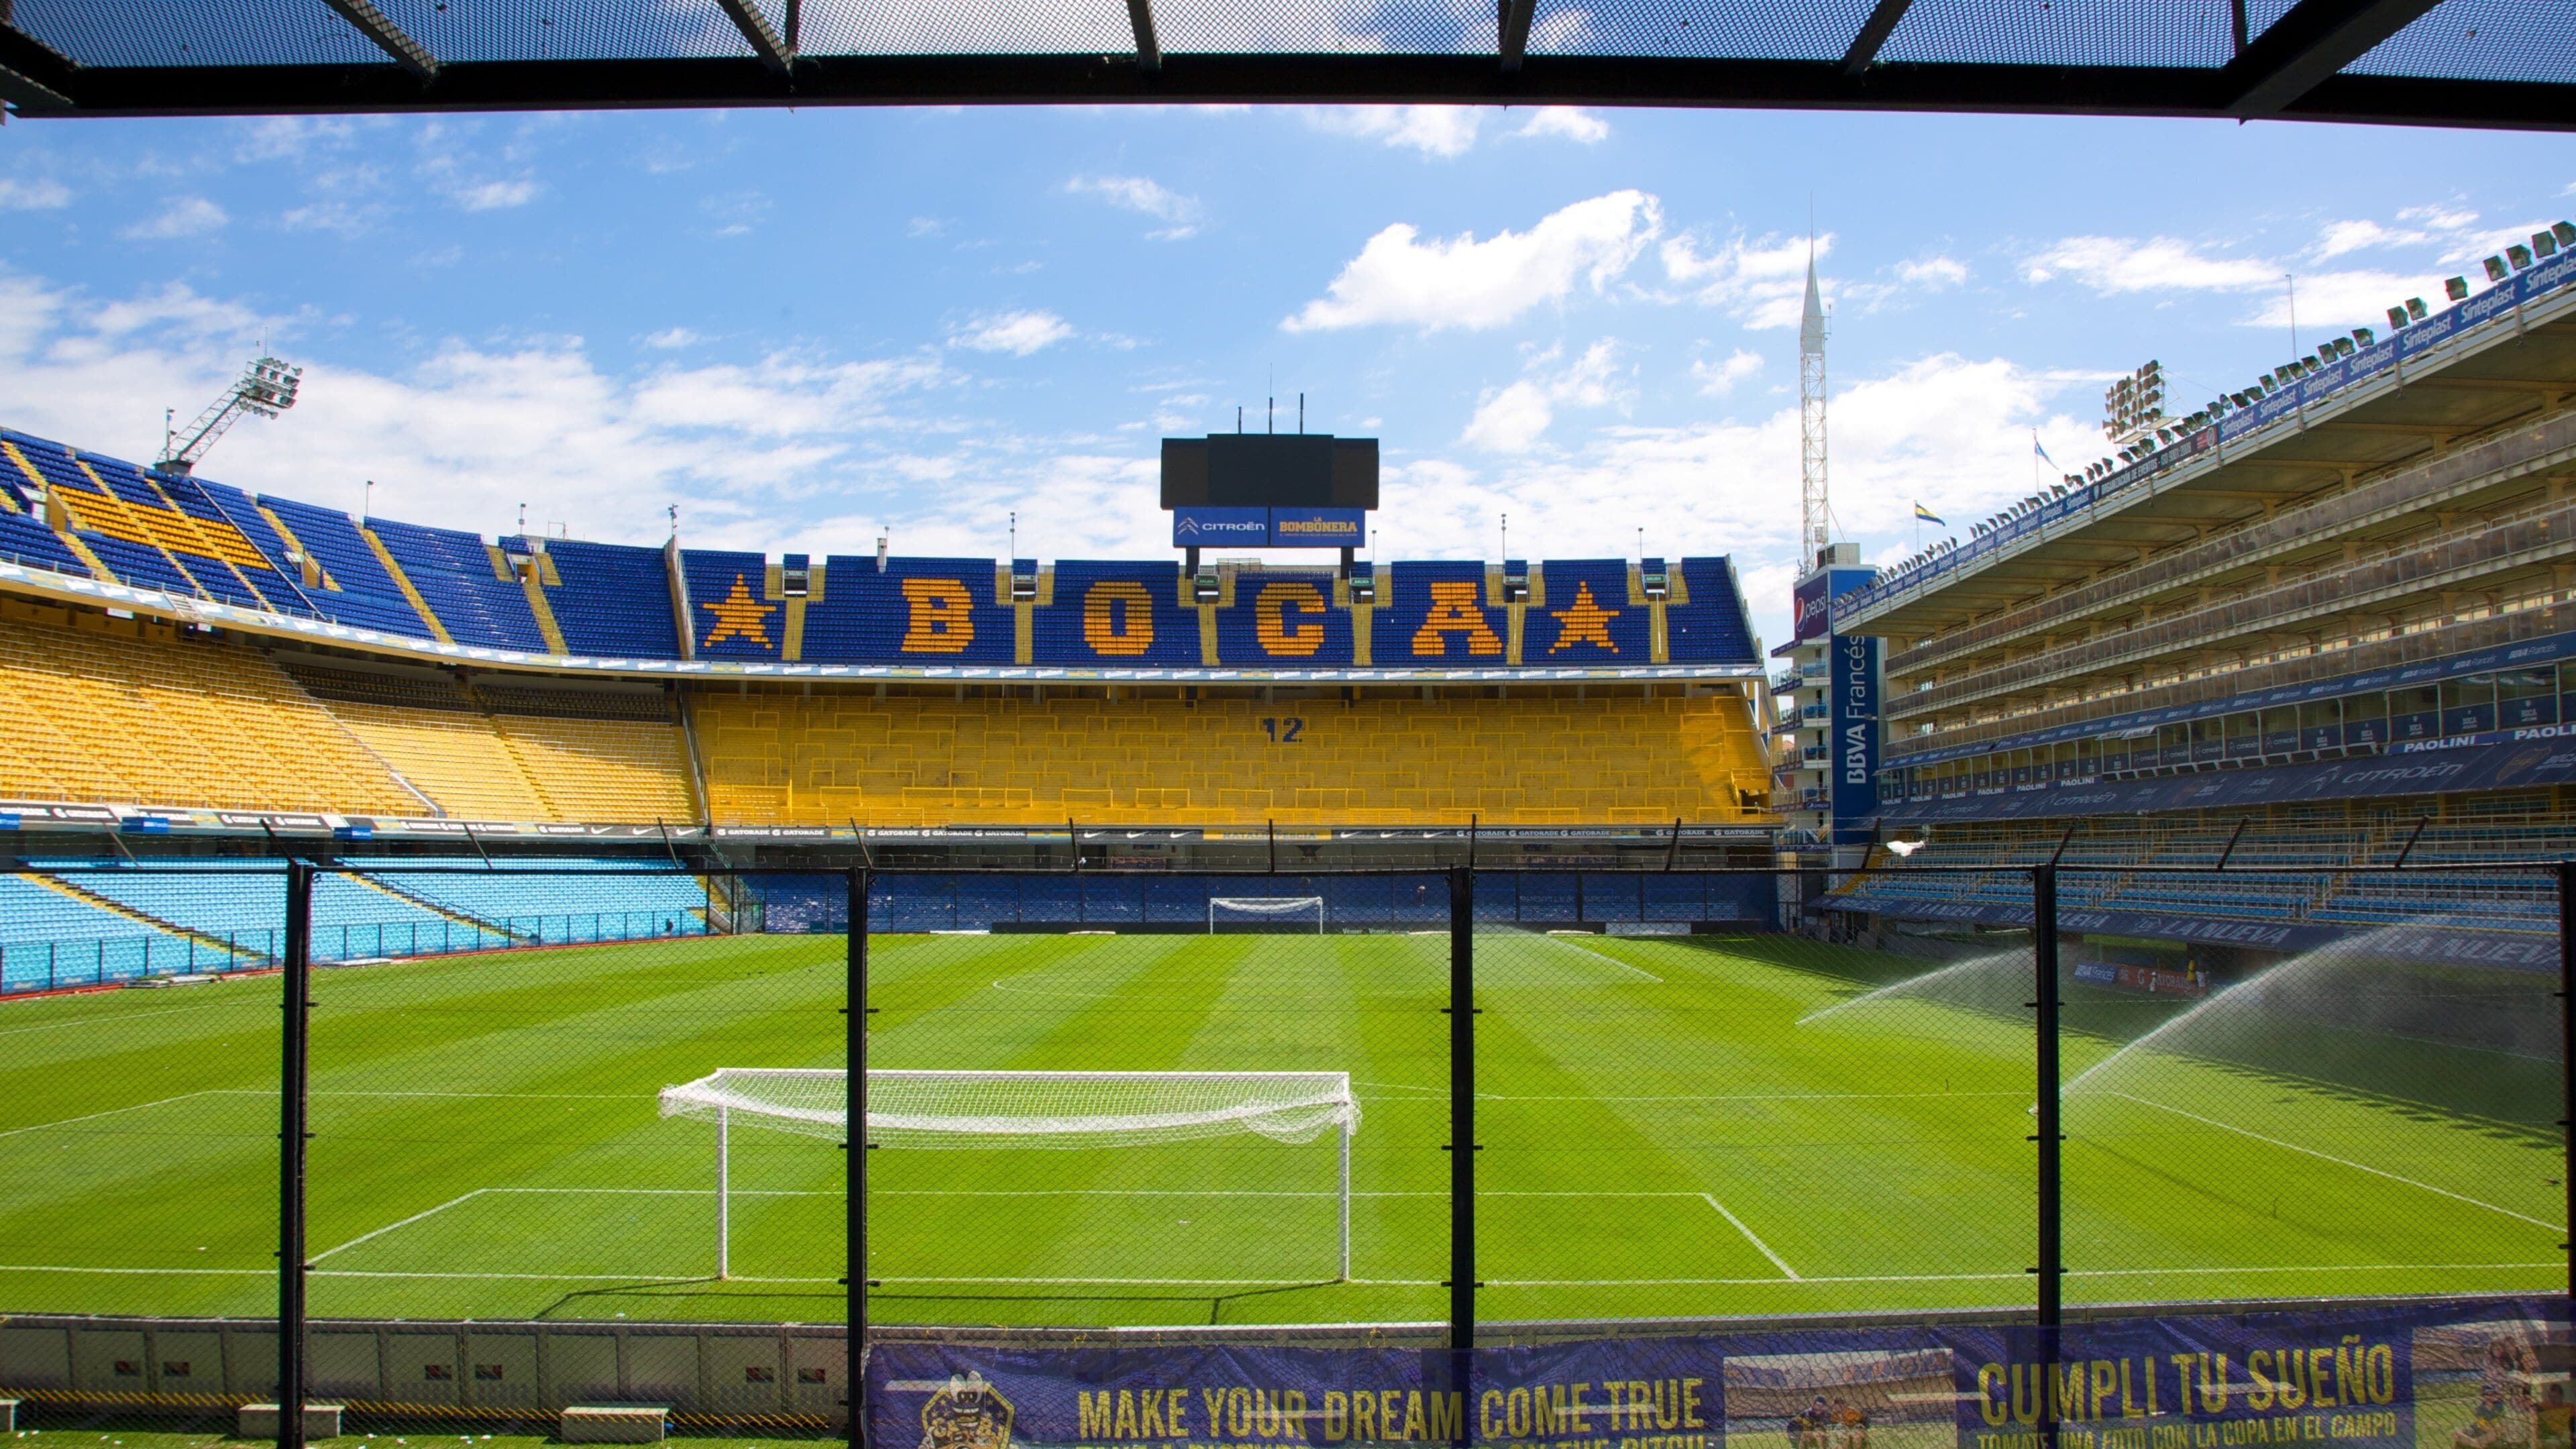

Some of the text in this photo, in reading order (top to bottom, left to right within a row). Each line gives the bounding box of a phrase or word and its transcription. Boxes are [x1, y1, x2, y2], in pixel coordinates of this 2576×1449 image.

[2461, 283, 2515, 323] Sinteplast
[2403, 315, 2452, 351] Sinteplast
[2350, 343, 2394, 375] Sinteplast
[2304, 367, 2343, 397] Sinteplast
[2260, 388, 2296, 418] Sinteplast
[2222, 410, 2254, 436] Sinteplast
[1279, 521, 1358, 532] BOMBONERA
[1805, 591, 1827, 623] pepsi
[1844, 635, 1866, 719] Francés
[1262, 717, 1302, 743] 12
[2404, 736, 2475, 753] PAOLINI
[1846, 724, 1866, 784] BBVA
[1941, 792, 1966, 800] PAOLINI
[1978, 788, 2004, 796] PAOLINI
[2017, 783, 2046, 792] PAOLINI
[2061, 777, 2094, 787] PAOLINI
[2159, 920, 2291, 944] LA NUEVA
[1978, 1335, 2393, 1426] CUMPLI TU SUEÑO
[1078, 1378, 1705, 1441] MAKE YOUR DREAM COME TRUE
[2151, 1424, 2188, 1449] CON
[2195, 1424, 2217, 1448] LA
[2221, 1418, 2269, 1447] COPA
[2273, 1416, 2297, 1442] EN
[2304, 1414, 2324, 1440] EL
[2330, 1411, 2396, 1438] CAMPO
